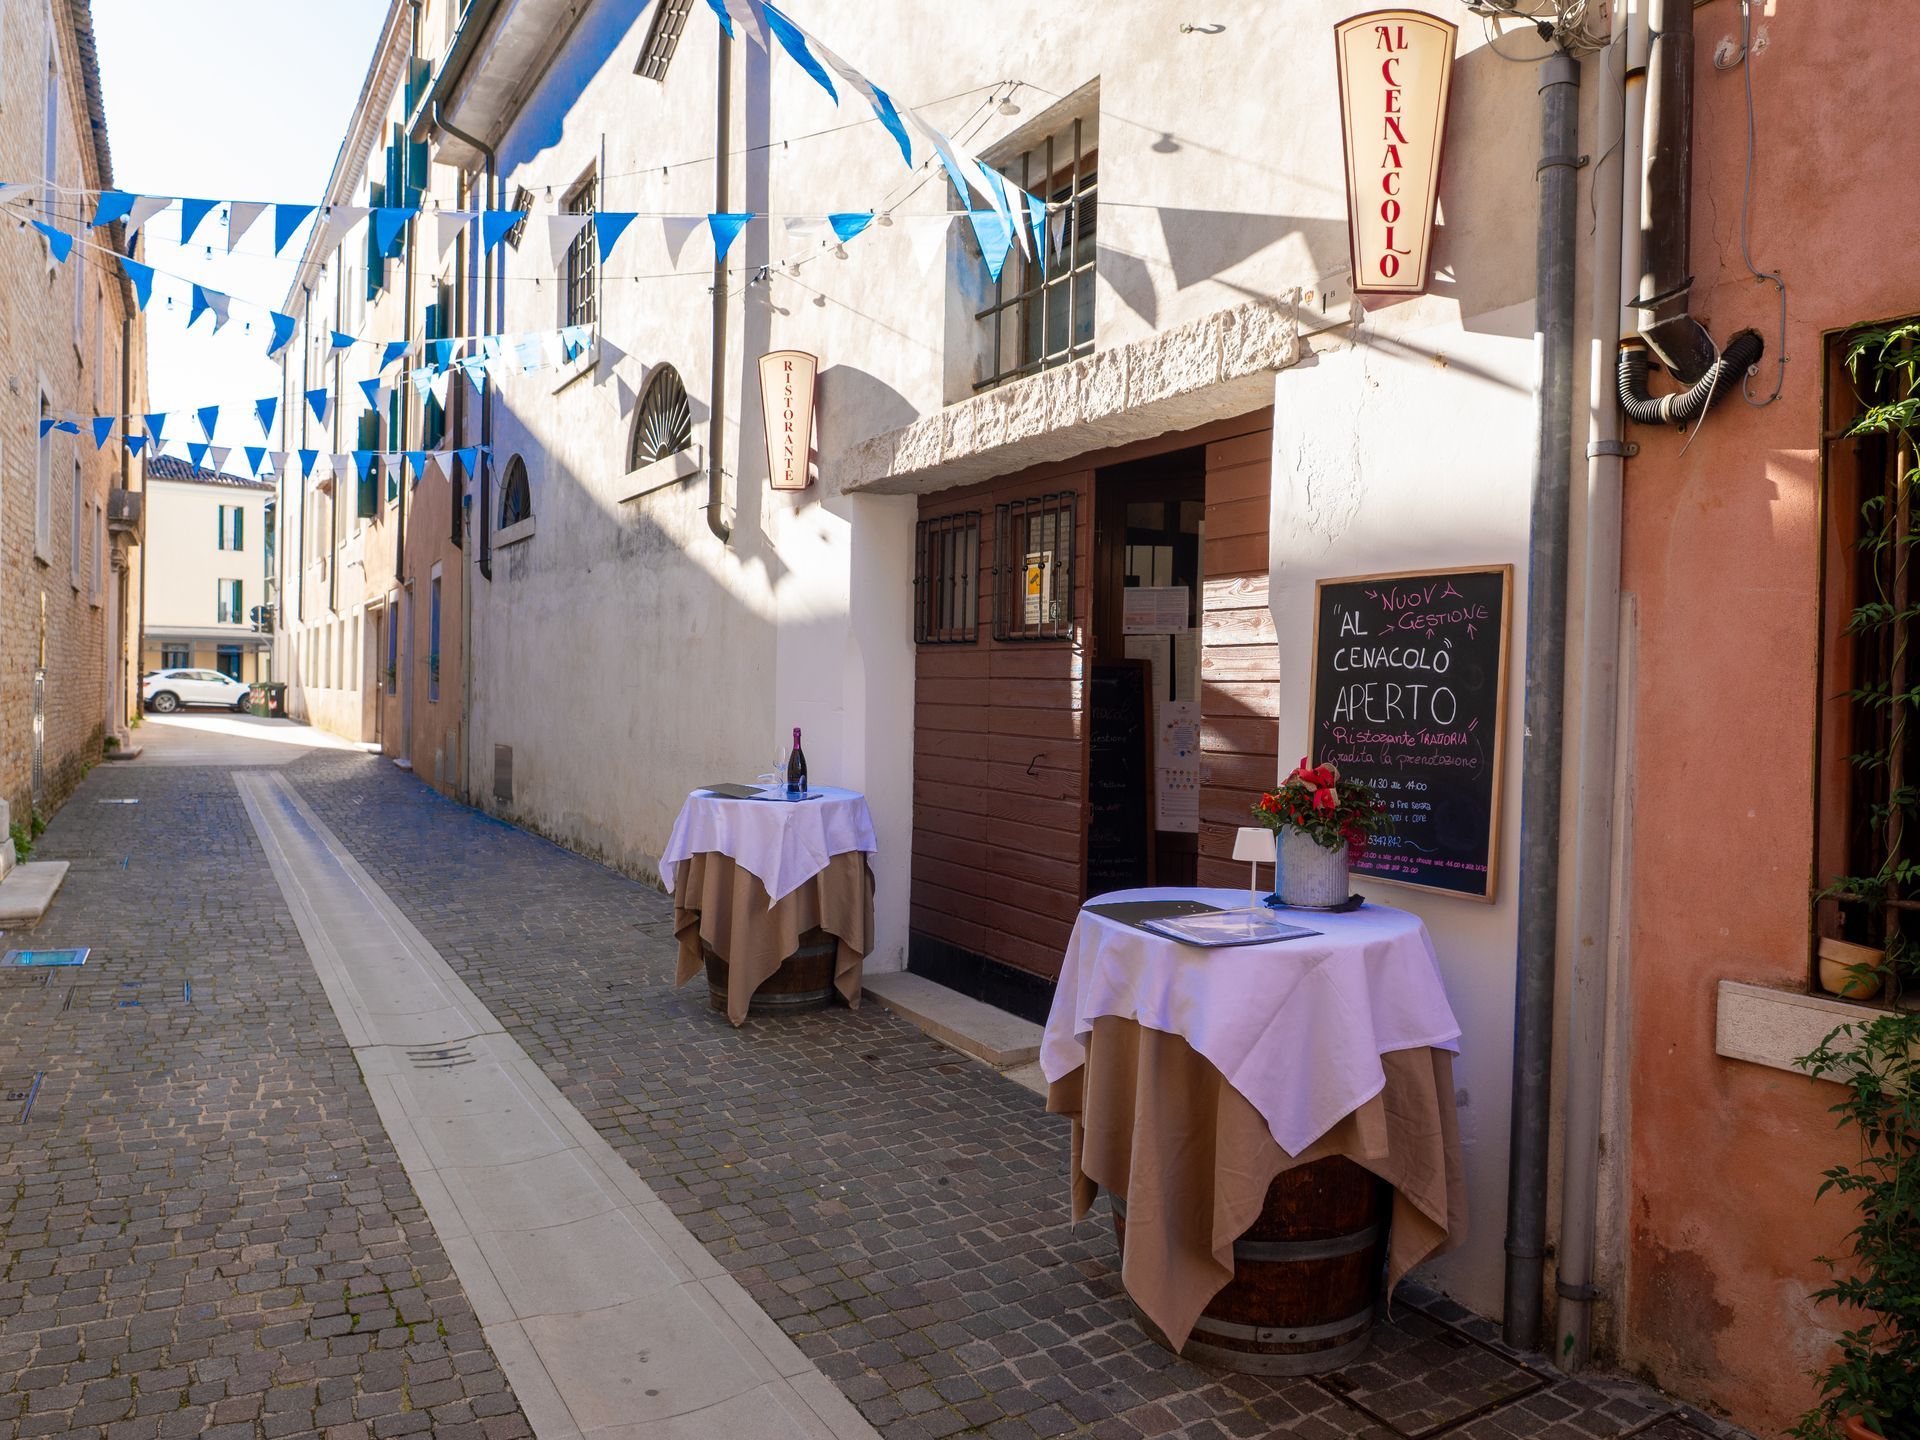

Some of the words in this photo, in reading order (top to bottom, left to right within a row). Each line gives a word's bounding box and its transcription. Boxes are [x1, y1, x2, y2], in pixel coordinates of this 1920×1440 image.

[1374, 26, 1409, 52] AL
[1379, 57, 1412, 279] CENACOLO
[783, 360, 794, 481] RISTORANTE
[1381, 581, 1463, 612] NUOVA
[1397, 603, 1489, 630] GESTIONE
[1332, 682, 1457, 725] APERTO
[1379, 742, 1393, 766] la
